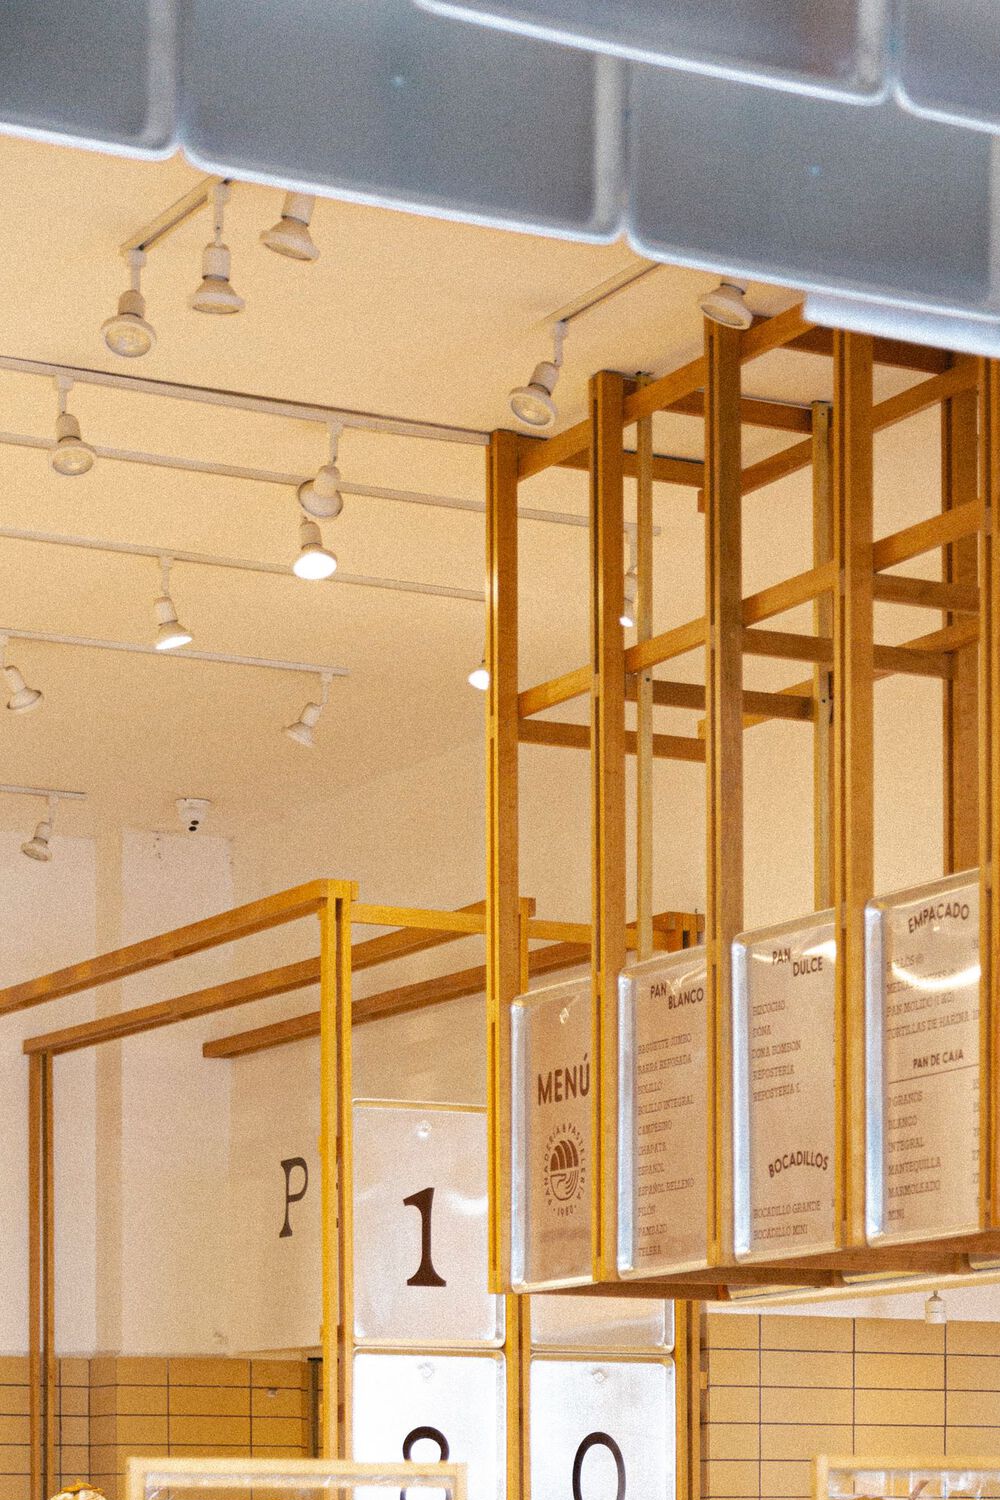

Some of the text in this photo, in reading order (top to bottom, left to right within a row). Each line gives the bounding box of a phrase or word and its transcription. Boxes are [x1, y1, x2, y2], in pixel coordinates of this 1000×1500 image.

[908, 902, 971, 934] EMPACADO
[772, 947, 791, 966] PAN
[793, 956, 823, 977] DULCE
[650, 982, 667, 999] PAN
[668, 987, 704, 1010] BLANCO
[913, 1049, 964, 1069] PAN DE CAJA
[537, 1053, 591, 1106] MENÚ
[768, 1151, 829, 1178] BOCADILLOS
[402, 1186, 447, 1288] 1
